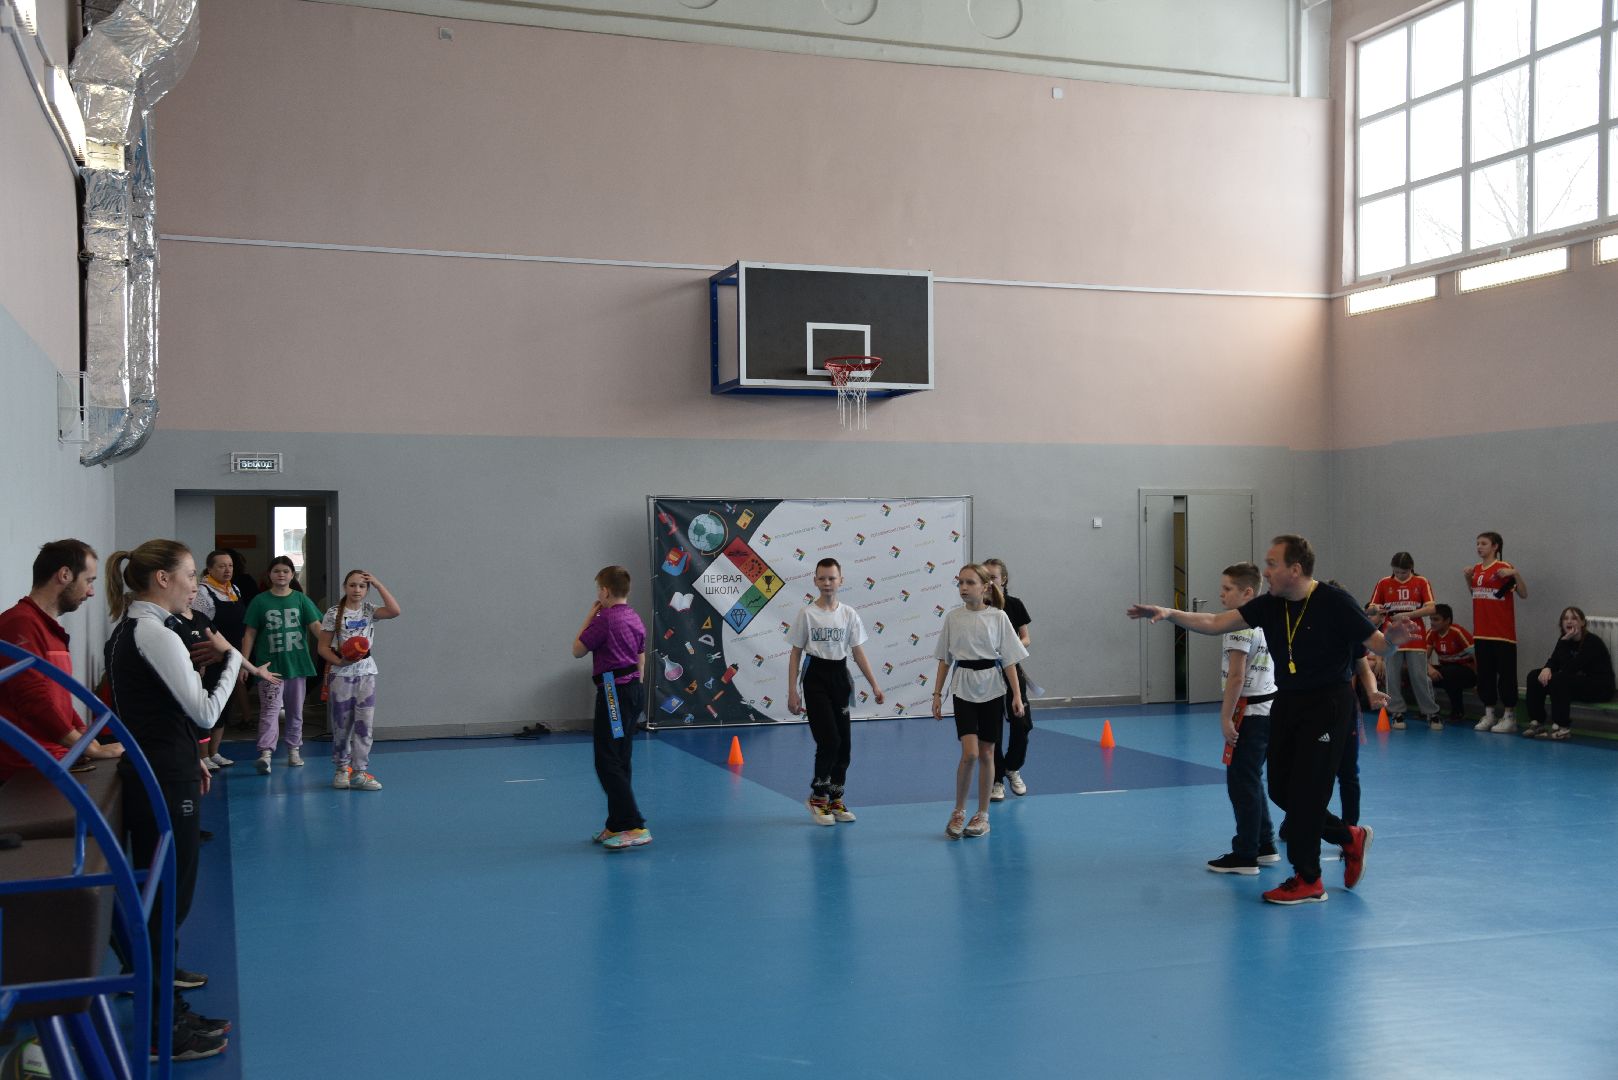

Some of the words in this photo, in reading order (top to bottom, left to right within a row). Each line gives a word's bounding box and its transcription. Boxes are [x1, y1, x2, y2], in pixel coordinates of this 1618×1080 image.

[241, 460, 273, 469] ВЫХОД
[703, 574, 742, 583] ПЕРВАЯ
[705, 586, 740, 595] ШКОЛА
[1397, 589, 1409, 600] 10
[265, 608, 300, 629] SB
[268, 631, 304, 652] ER
